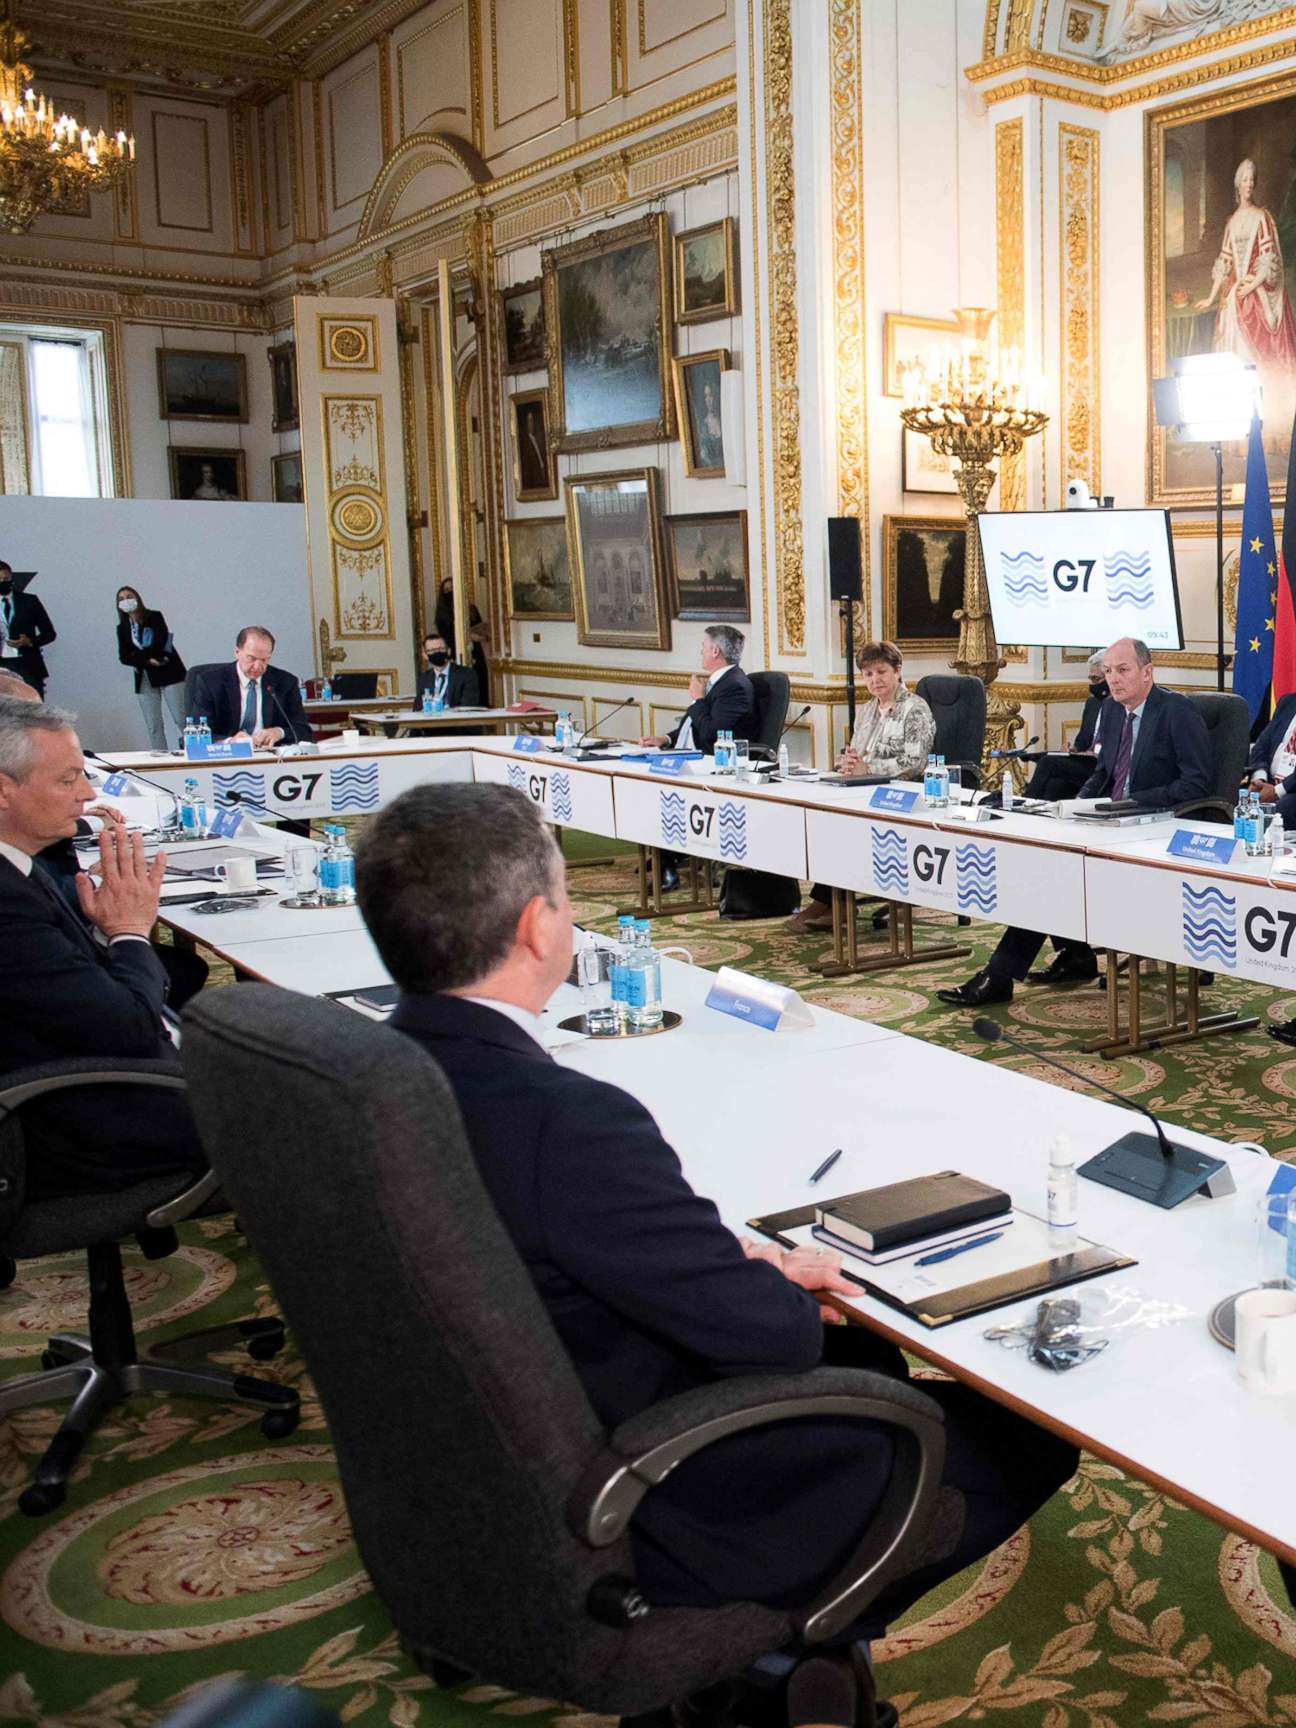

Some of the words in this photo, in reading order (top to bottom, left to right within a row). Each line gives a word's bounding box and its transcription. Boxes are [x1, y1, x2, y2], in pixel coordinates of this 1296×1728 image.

[1053, 559, 1097, 593] G7
[273, 773, 323, 801] G7
[529, 775, 547, 803] G7
[689, 804, 715, 838] G7
[913, 844, 951, 885] G7
